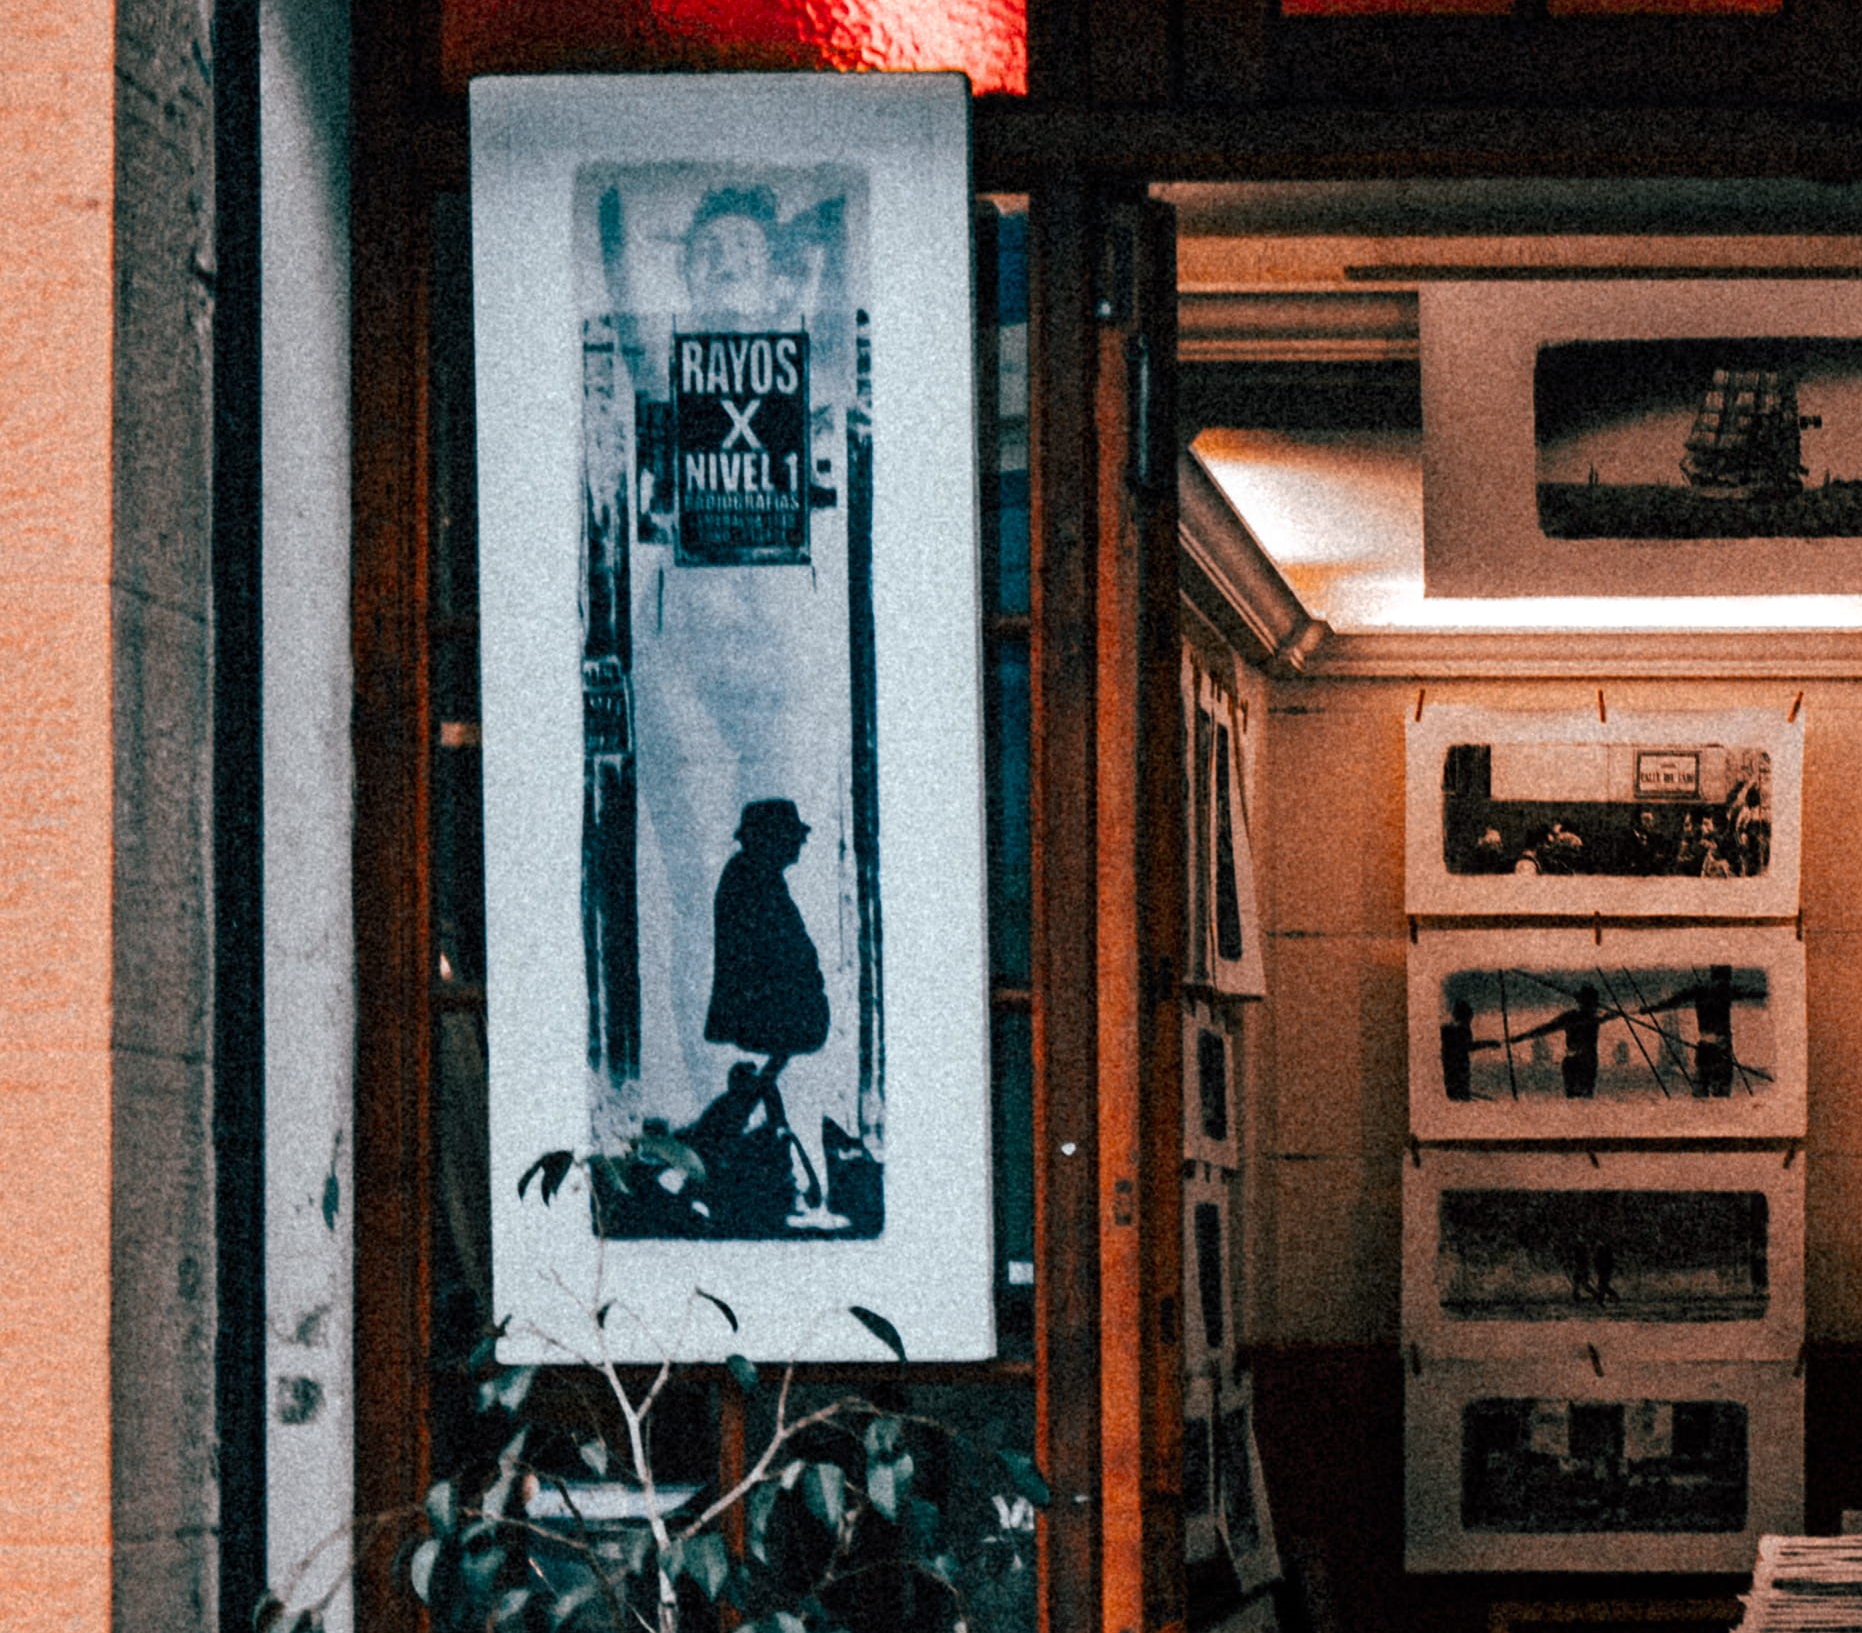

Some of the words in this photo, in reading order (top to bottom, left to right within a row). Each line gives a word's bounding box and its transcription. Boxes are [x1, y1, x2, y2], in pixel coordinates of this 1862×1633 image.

[681, 338, 799, 395] RAYOS
[720, 399, 762, 450] X
[685, 452, 775, 493] NIVEL
[783, 452, 799, 493] 1
